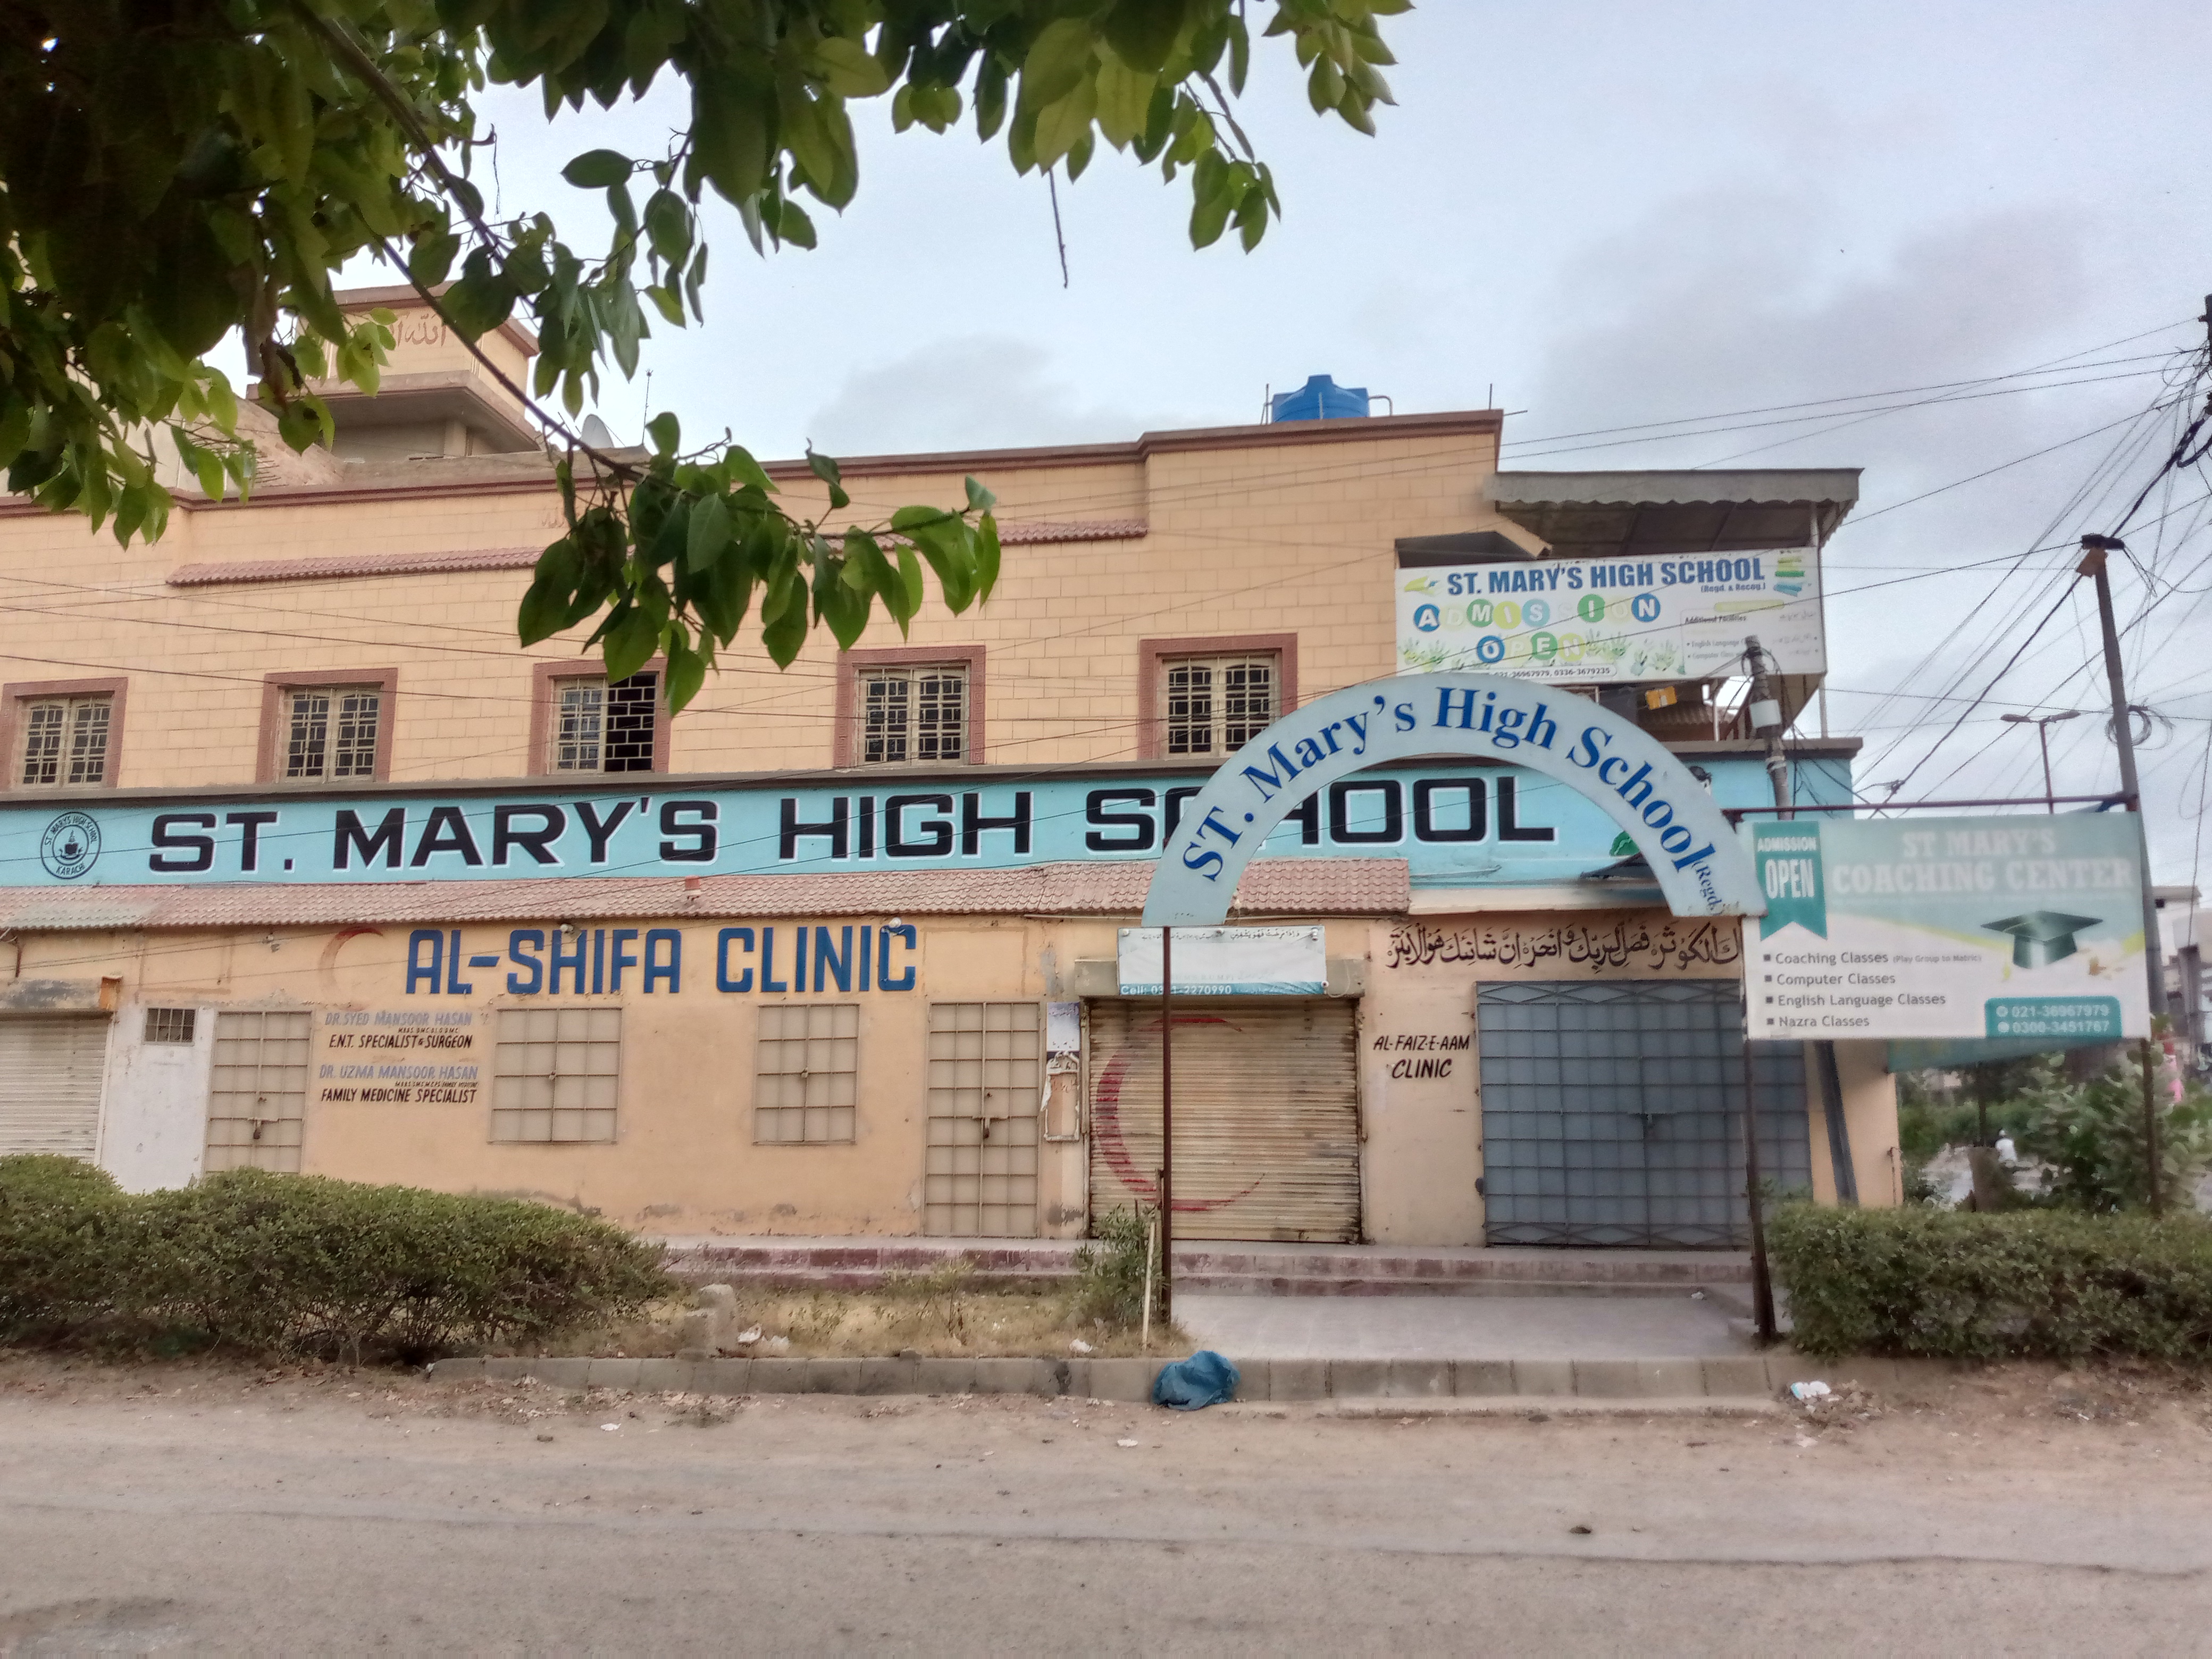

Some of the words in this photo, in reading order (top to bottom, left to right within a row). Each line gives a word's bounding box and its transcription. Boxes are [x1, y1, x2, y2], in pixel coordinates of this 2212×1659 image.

[1447, 572, 1482, 596] ST.
[1489, 566, 1583, 593] MARY'S
[1590, 562, 1654, 588] HIGH
[1661, 557, 1765, 585] SCHOOL
[1415, 594, 1659, 631] ADMISSION
[1480, 636, 1582, 659] OPEN
[1183, 805, 1255, 882] ST.
[1239, 696, 1417, 803] Mary's
[1431, 687, 1559, 750] High
[1566, 726, 1716, 874] School
[149, 811, 294, 871] ST.
[333, 797, 717, 868] MARY'S
[780, 791, 1033, 859] HIGH
[1756, 836, 1817, 852] ADMISSION
[1902, 831, 1937, 858] ST
[1945, 827, 2057, 856] MARY'S
[1764, 858, 1815, 900] OPEN
[1832, 860, 1995, 893] COACHING
[2006, 857, 2135, 890] CENTER
[406, 928, 681, 994] AL-SHIFA
[716, 924, 916, 992] CLINIC
[1775, 953, 1837, 966] Coaching
[1841, 952, 1889, 963] Classes
[1777, 974, 1844, 987] Computer
[1848, 973, 1896, 985] Classes
[1151, 985, 1233, 995] 031-2270990
[1778, 995, 1825, 1008] English
[1830, 995, 1893, 1008] Language
[1897, 994, 1946, 1006] Classes
[434, 1012, 473, 1026] HASAN
[1779, 1016, 1817, 1027] Nazra
[1822, 1015, 1870, 1027] Classes
[328, 1034, 354, 1049] E.N.T.
[358, 1034, 418, 1049] SPECIALIST
[424, 1034, 473, 1049] SURGEON
[339, 1065, 374, 1079] UZMA
[378, 1065, 435, 1080] MANSOOR
[438, 1066, 479, 1080] HASAN
[1392, 1058, 1453, 1079] CLINIC
[321, 1087, 358, 1102] FAMILY
[360, 1087, 411, 1103] MEDICINE
[415, 1088, 478, 1104] SPECIALIST
